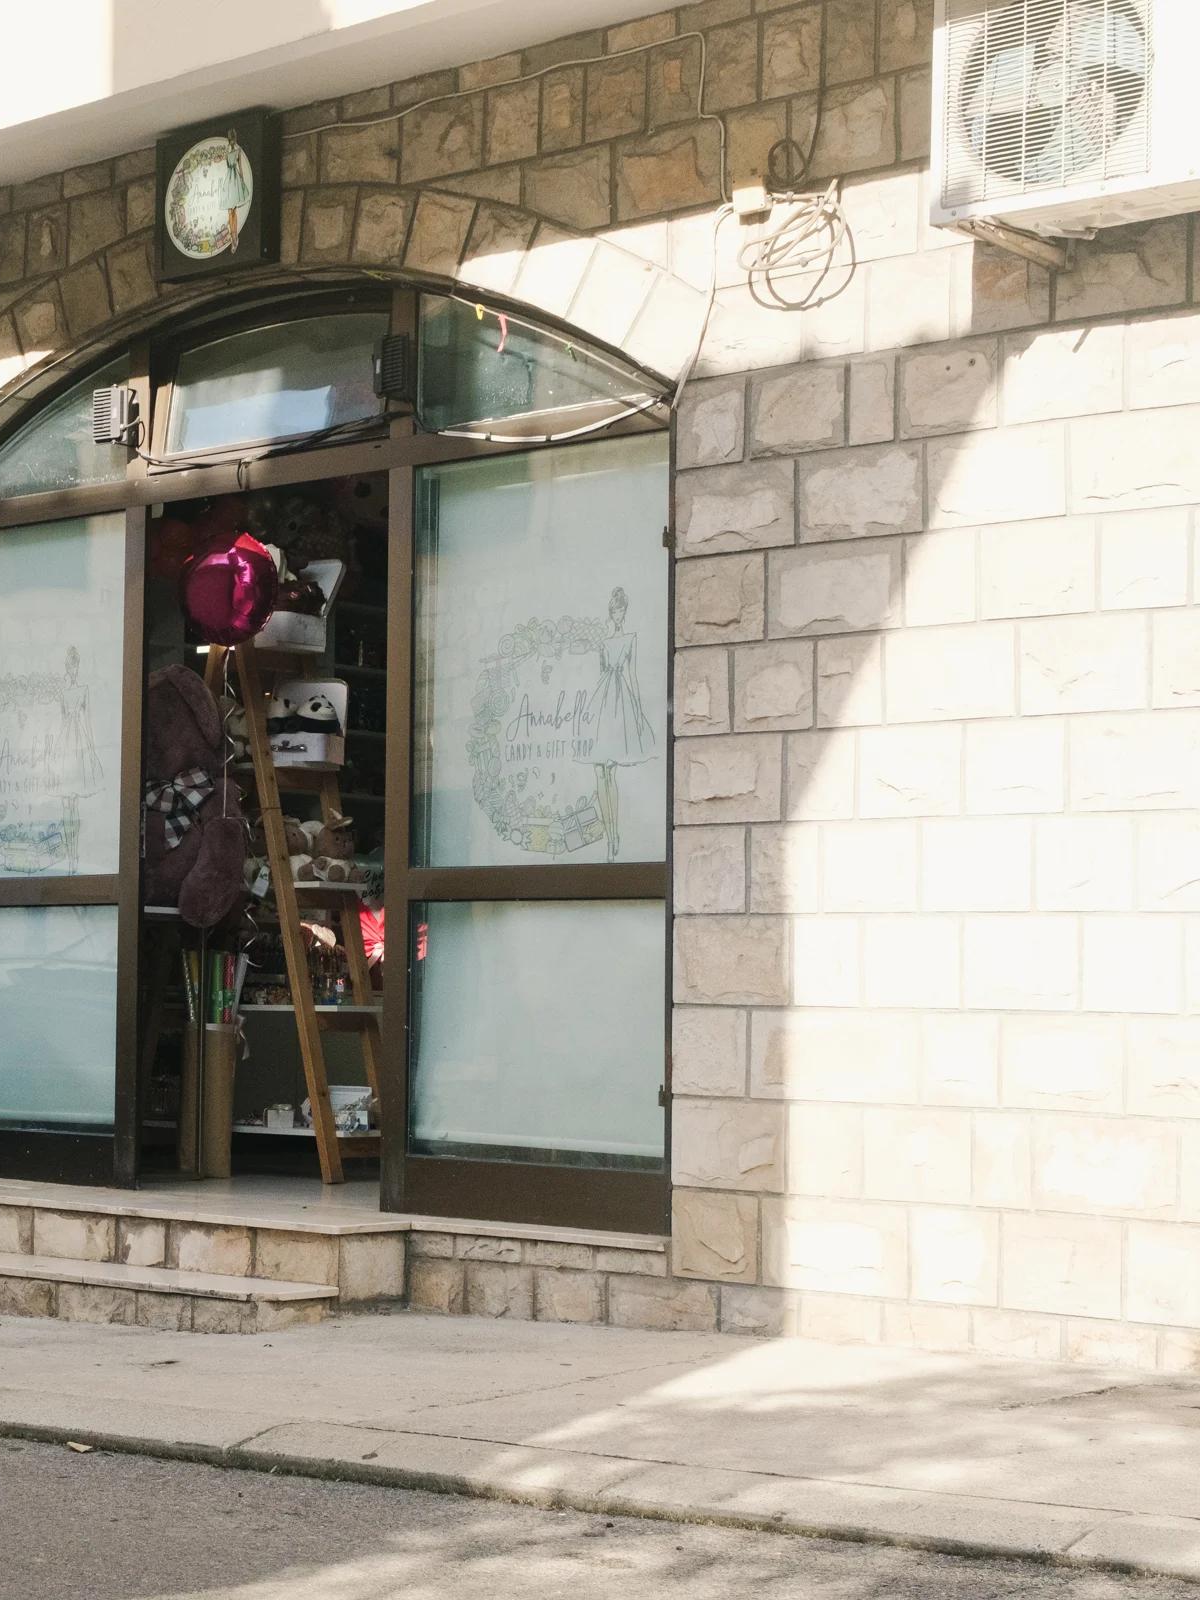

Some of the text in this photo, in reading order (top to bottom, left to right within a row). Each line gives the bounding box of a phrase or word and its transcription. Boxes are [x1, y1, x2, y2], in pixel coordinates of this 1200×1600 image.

[506, 689, 594, 742] Annabella
[505, 743, 531, 762] CANDY
[546, 740, 567, 759] GIFT
[572, 738, 593, 758] SHOP
